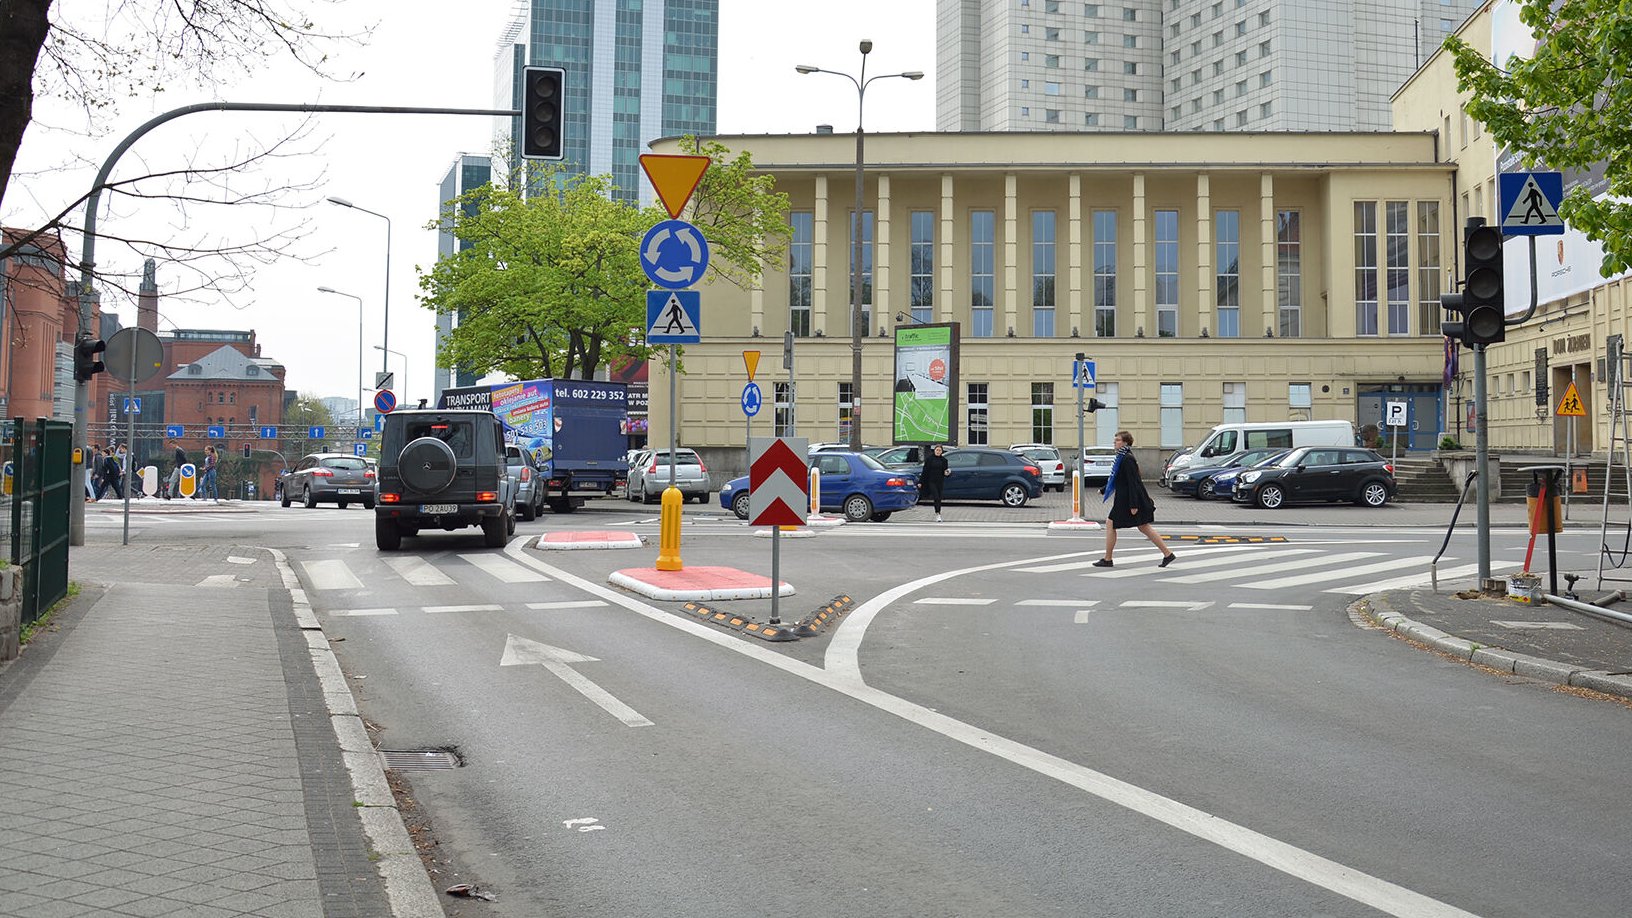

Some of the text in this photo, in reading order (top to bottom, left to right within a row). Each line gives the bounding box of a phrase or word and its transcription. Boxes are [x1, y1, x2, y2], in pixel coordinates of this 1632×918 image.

[446, 392, 491, 406] TRANSPORT
[555, 387, 570, 398] tel.
[572, 389, 589, 399] 602
[591, 390, 607, 400] 229
[609, 391, 625, 400] 352
[1391, 405, 1403, 418] P
[506, 429, 518, 440] 501
[534, 420, 547, 431] 503
